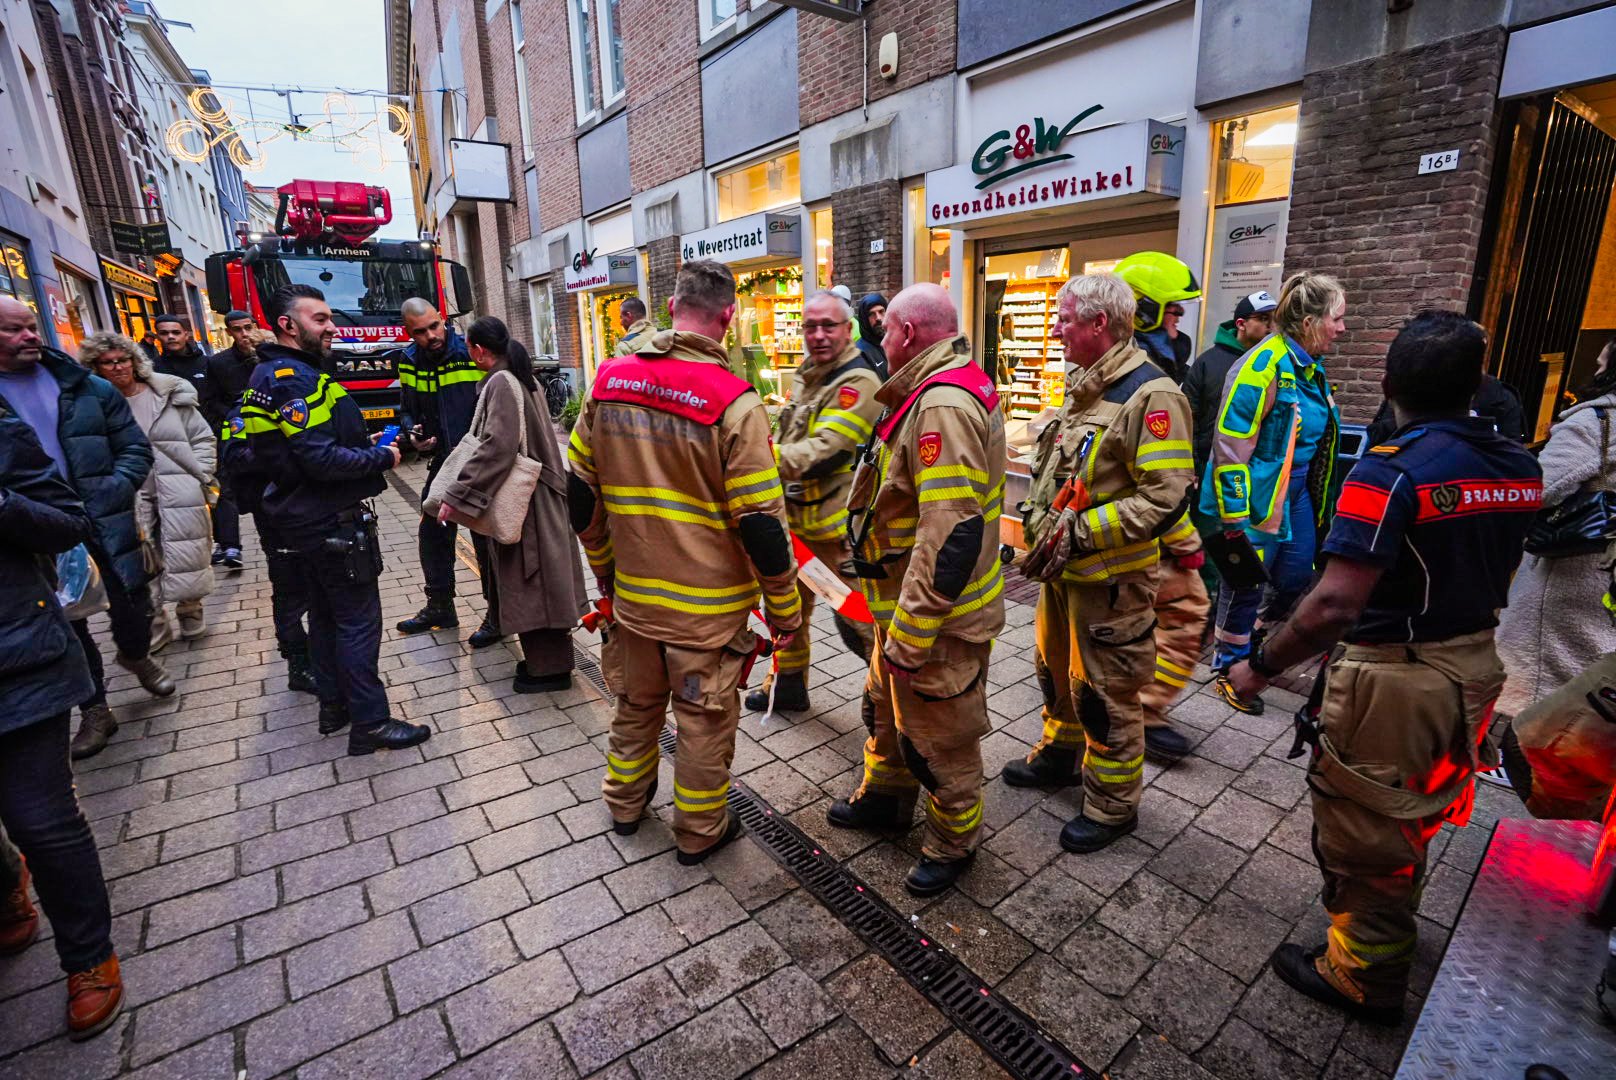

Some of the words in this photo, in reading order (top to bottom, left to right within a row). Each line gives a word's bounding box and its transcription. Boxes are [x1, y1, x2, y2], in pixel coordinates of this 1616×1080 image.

[971, 104, 1104, 177] G&W
[1150, 134, 1183, 151] G&W
[932, 166, 1134, 220] GezondheidsWinkel
[768, 220, 798, 231] G&W
[1229, 223, 1276, 240] G&W
[325, 246, 370, 256] Arnhem
[683, 244, 694, 260] de
[697, 226, 763, 256] Weverstraat
[333, 327, 404, 338] ANDWEER
[336, 359, 392, 372] MAN
[607, 376, 708, 409] Bevelvoerder
[1233, 475, 1244, 499] GHOR
